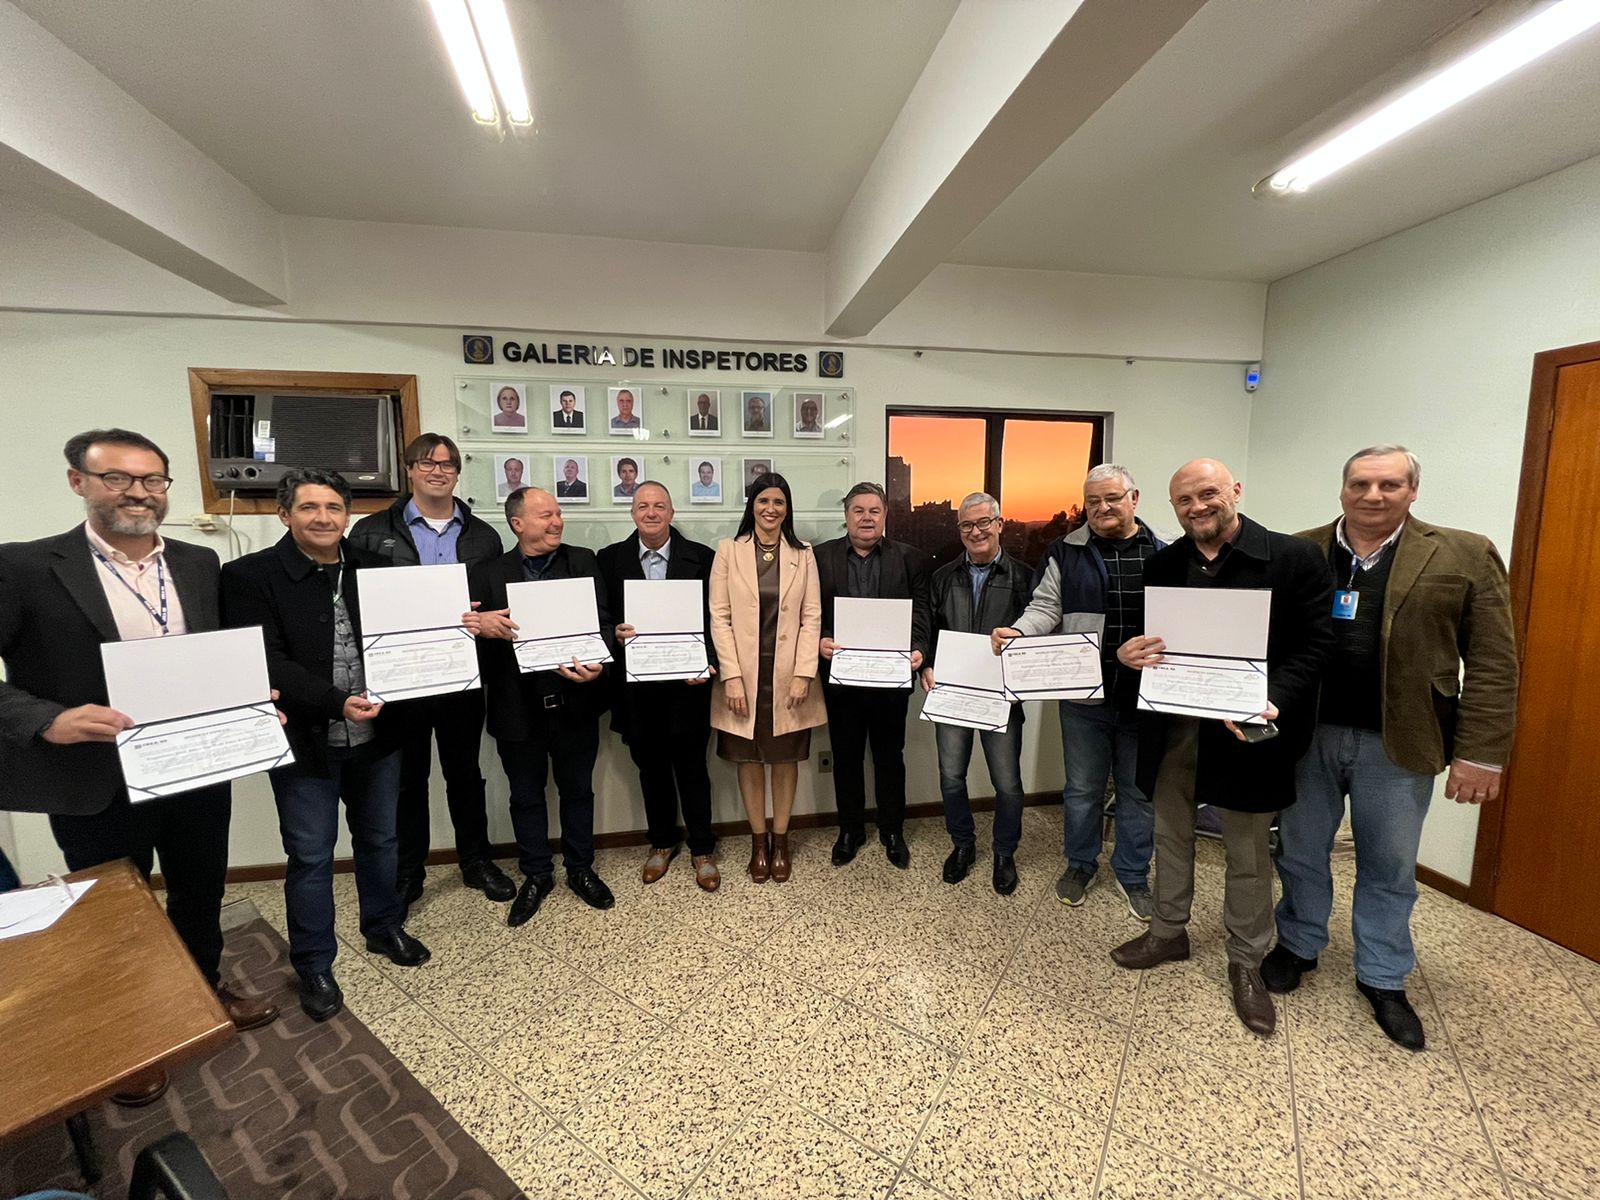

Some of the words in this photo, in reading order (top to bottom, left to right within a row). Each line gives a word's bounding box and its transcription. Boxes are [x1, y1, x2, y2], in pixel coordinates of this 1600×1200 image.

[502, 341, 616, 366] GALERIA
[622, 347, 655, 368] DE
[662, 348, 808, 372] INSPETORES
